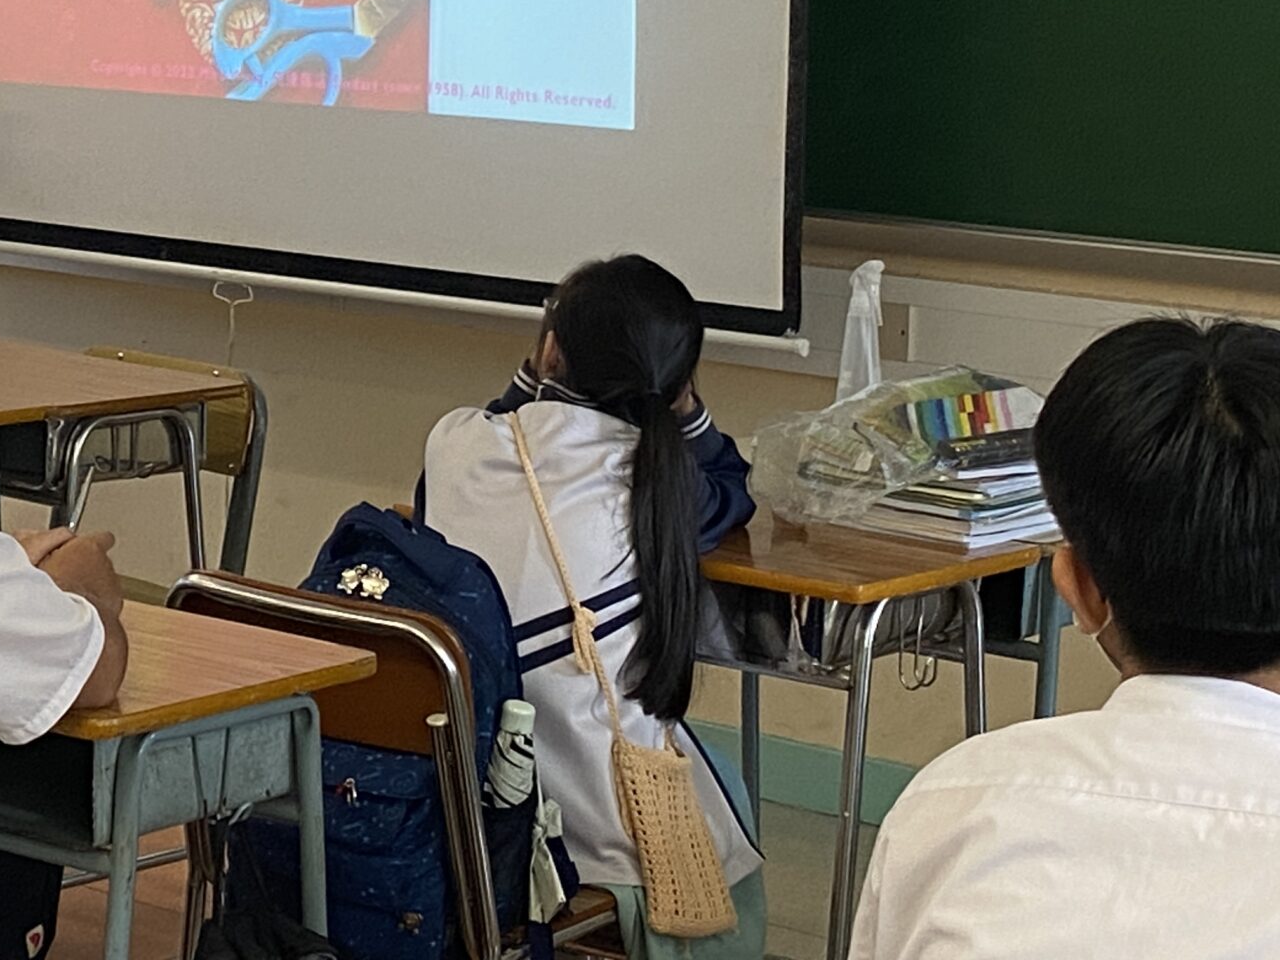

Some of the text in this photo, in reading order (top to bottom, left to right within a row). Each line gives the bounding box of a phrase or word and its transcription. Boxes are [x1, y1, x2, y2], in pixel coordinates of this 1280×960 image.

[471, 84, 490, 99] All
[496, 86, 538, 105] Rights
[544, 89, 616, 109] Reserved.
